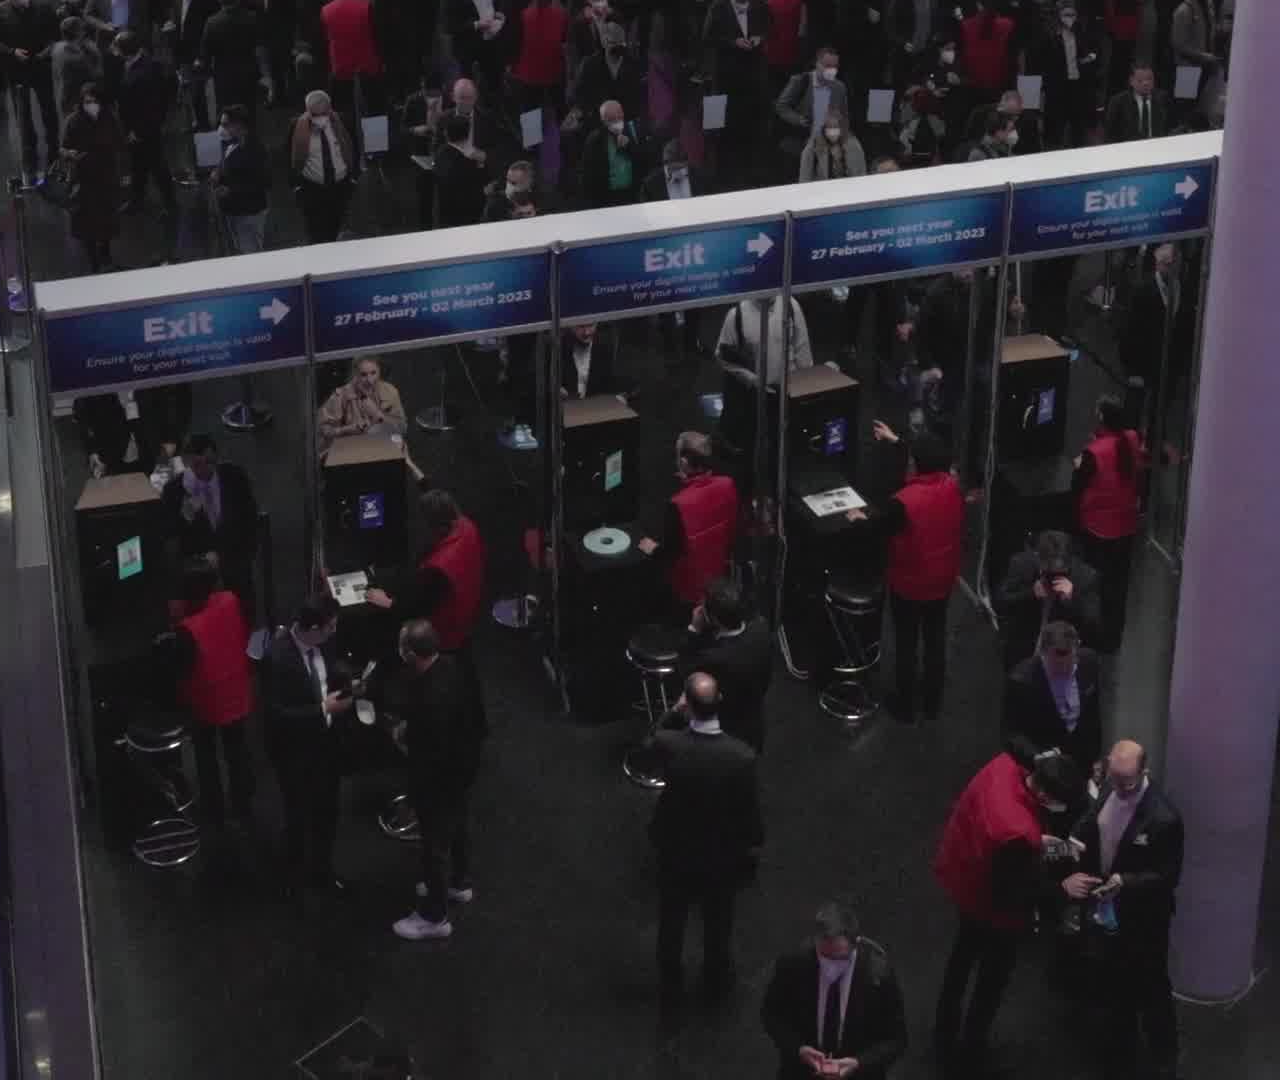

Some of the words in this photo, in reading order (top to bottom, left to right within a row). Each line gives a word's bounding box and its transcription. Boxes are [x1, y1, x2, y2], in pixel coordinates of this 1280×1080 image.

[1084, 185, 1140, 213] Exit
[811, 248, 827, 260] 27
[828, 241, 886, 258] February
[954, 227, 986, 240] 2023
[846, 229, 871, 241] See
[871, 226, 895, 239] you
[644, 242, 705, 273] Exit
[334, 313, 352, 326] 27
[354, 304, 419, 325] February
[452, 294, 495, 310] March
[497, 289, 533, 304] 2023
[372, 294, 400, 307] See
[401, 291, 428, 306] you
[143, 311, 215, 343] Exit
